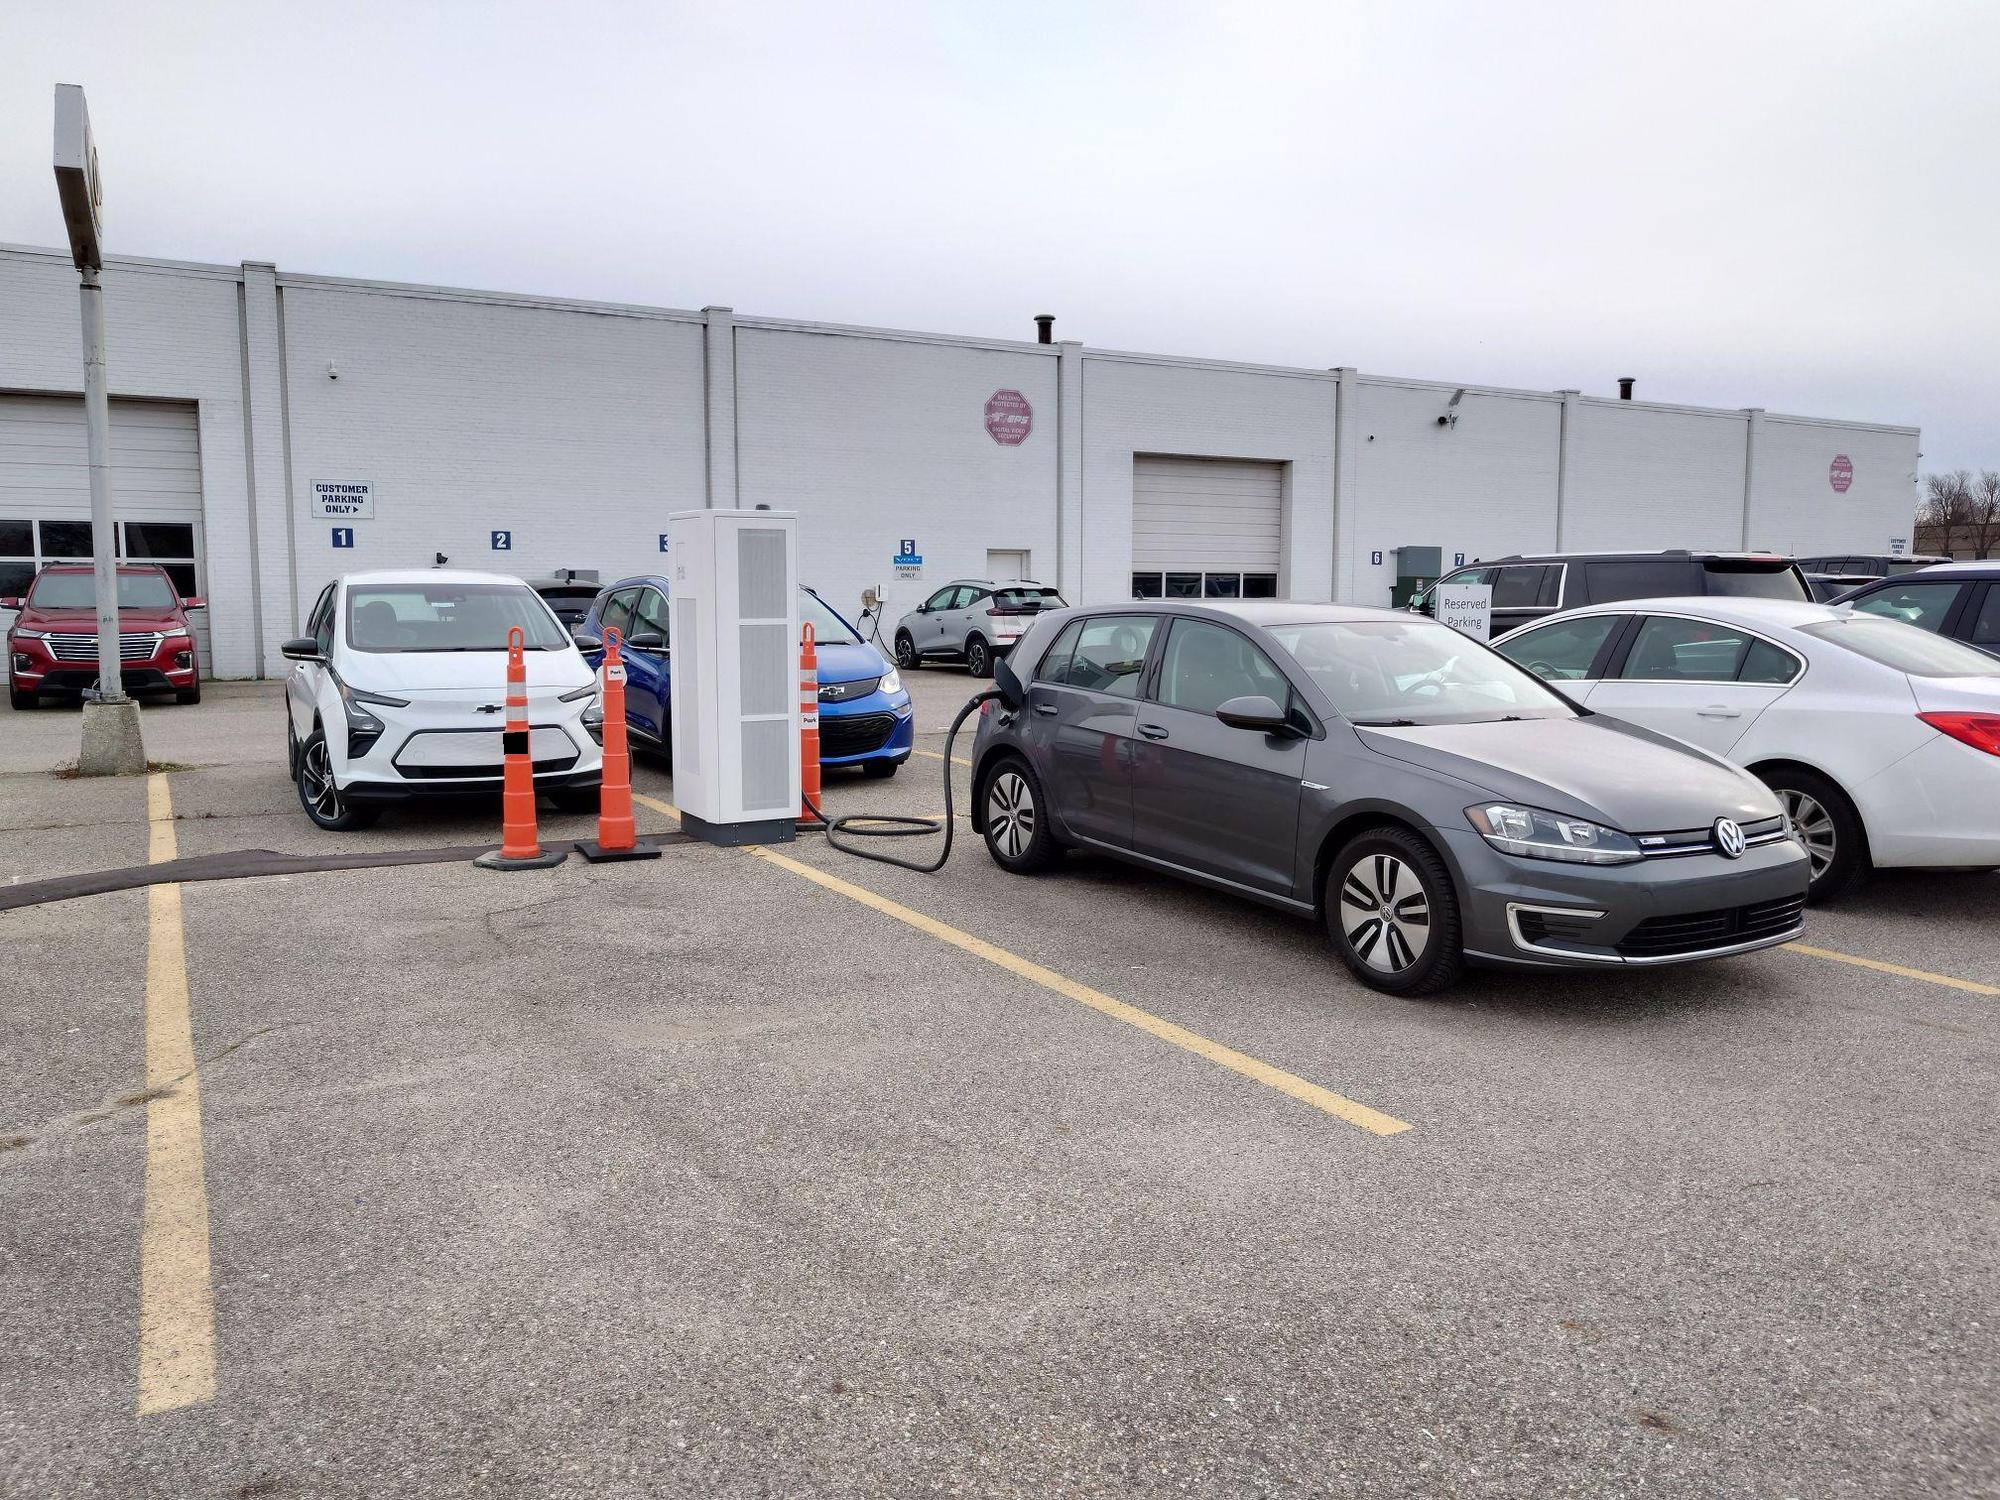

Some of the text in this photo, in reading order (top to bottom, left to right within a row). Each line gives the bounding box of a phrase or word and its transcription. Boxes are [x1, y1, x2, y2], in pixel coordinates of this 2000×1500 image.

[316, 484, 368, 493] CUSTOMER
[321, 494, 364, 503] PARKING
[325, 504, 350, 513] ONLY
[337, 529, 347, 546] 1
[496, 533, 506, 548] 2
[904, 541, 912, 554] 5
[1374, 552, 1380, 564] 6
[1456, 554, 1463, 565] 7
[1444, 598, 1486, 609] Reserved
[1447, 616, 1482, 630] Parking
